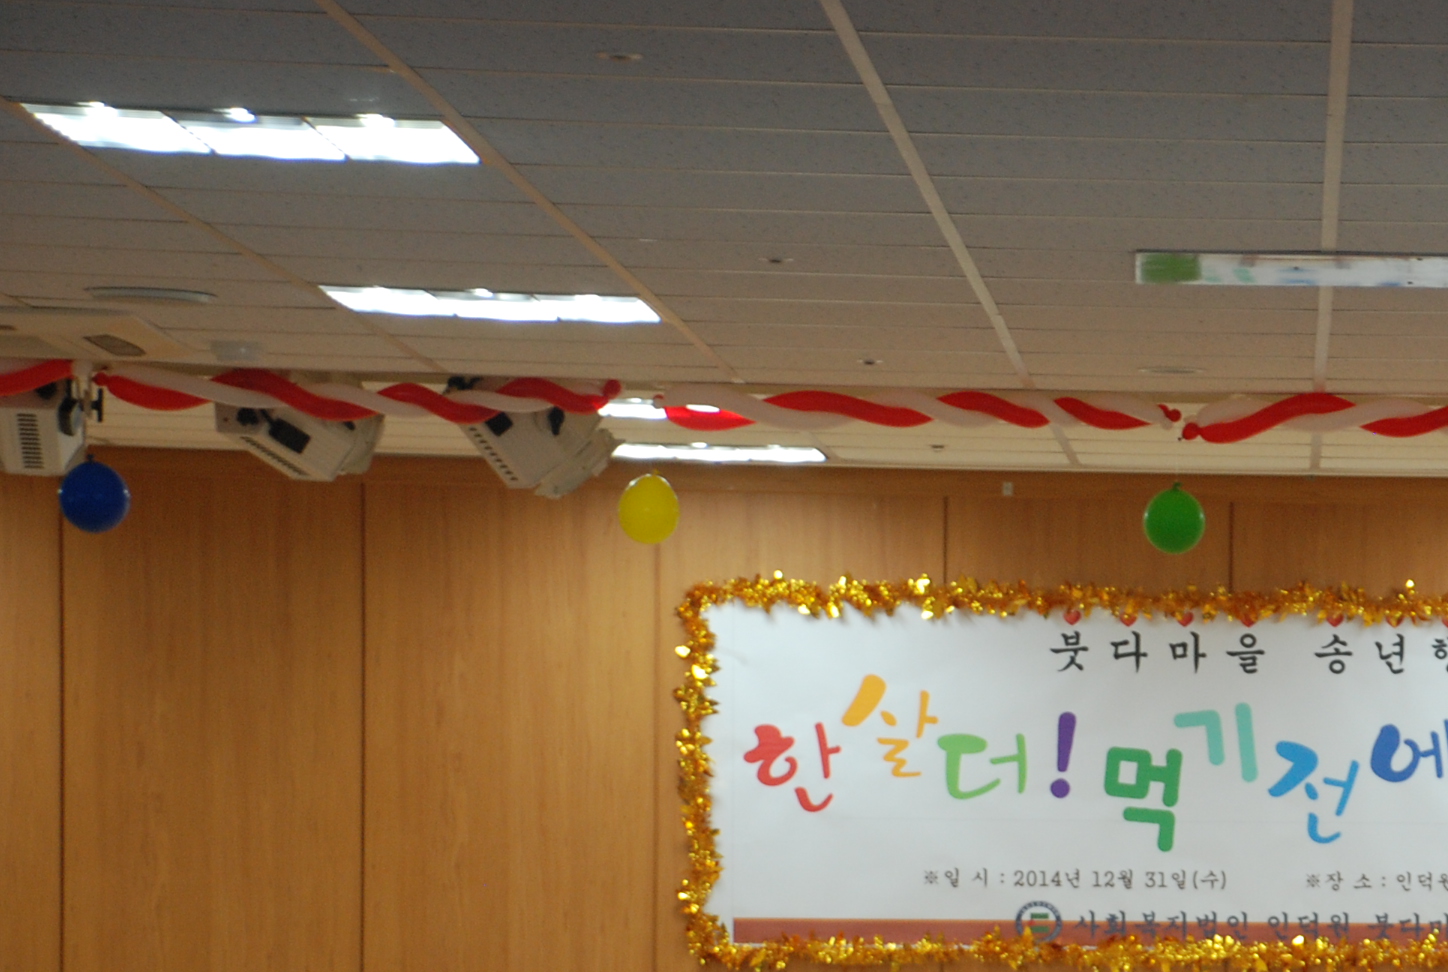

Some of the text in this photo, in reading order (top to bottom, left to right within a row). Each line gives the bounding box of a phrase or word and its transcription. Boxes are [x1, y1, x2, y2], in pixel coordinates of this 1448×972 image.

[1050, 631, 1265, 674] 붓다마을
[1013, 868, 1081, 889] 2014년
[1092, 868, 1134, 890] 12월
[1144, 868, 1228, 891] 31일(수)
